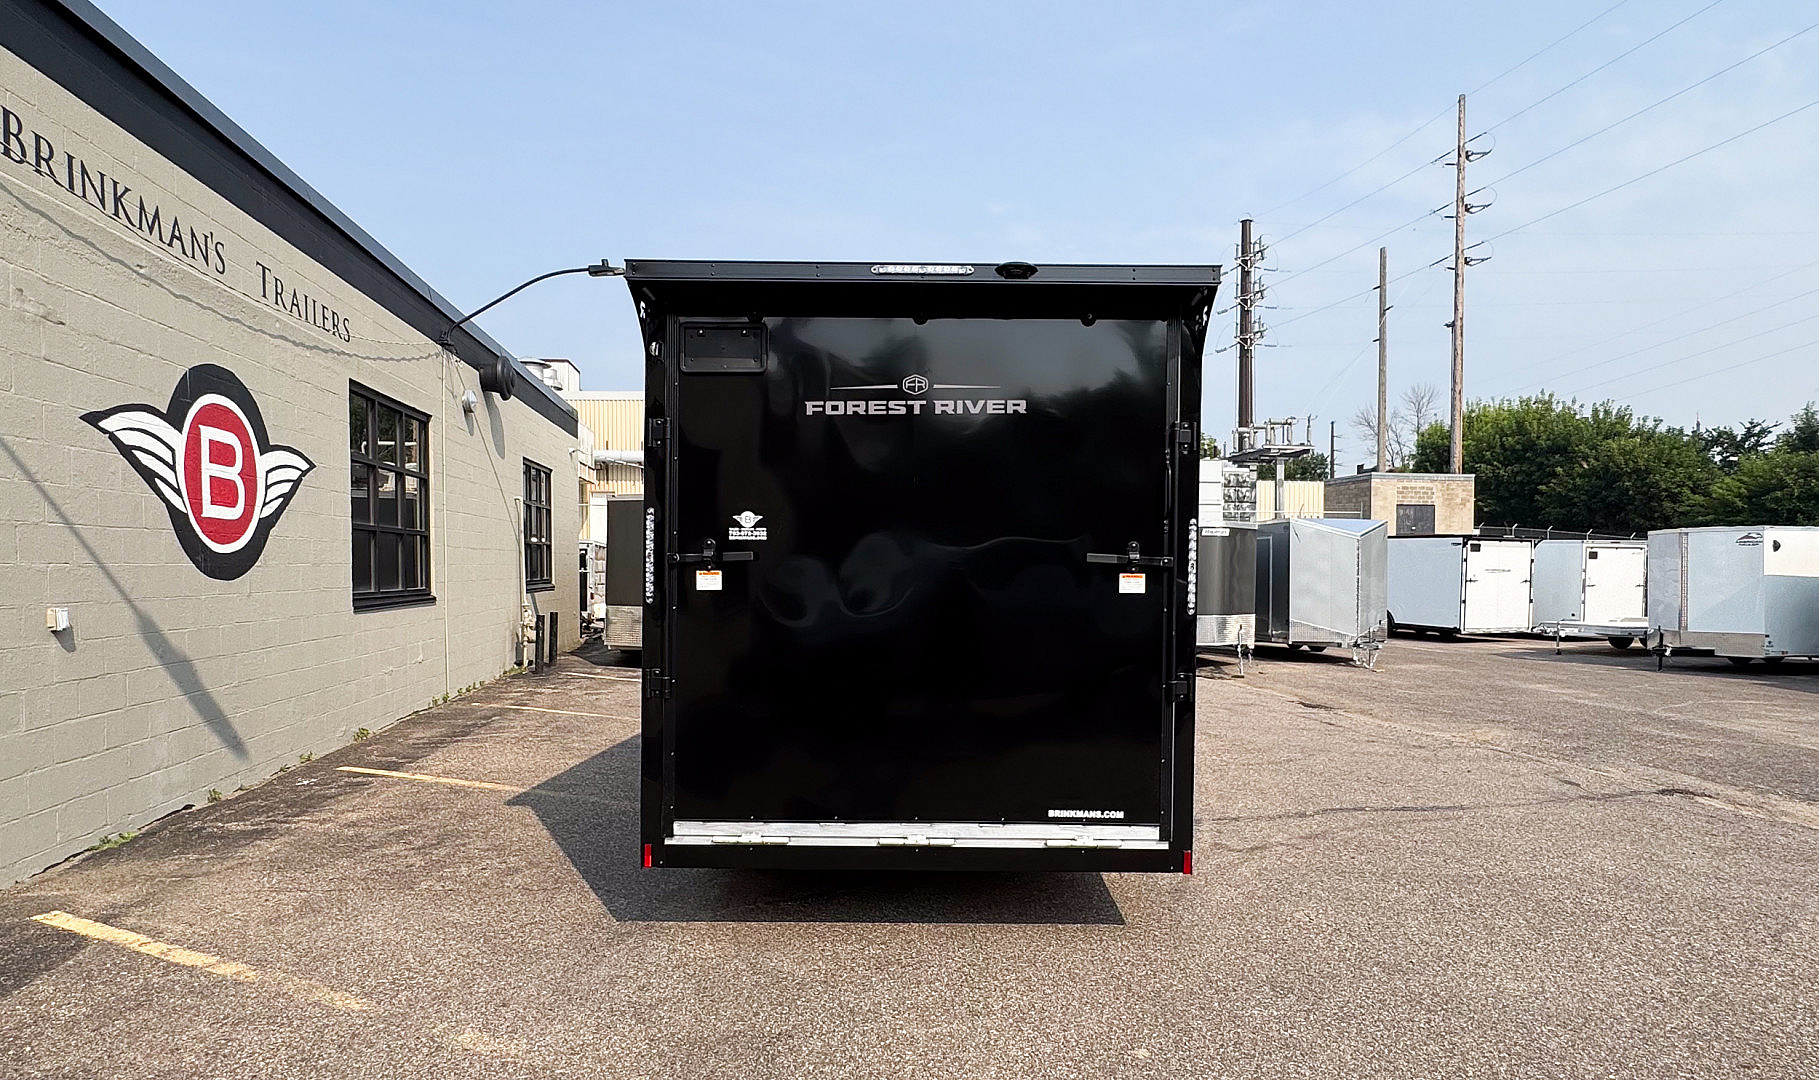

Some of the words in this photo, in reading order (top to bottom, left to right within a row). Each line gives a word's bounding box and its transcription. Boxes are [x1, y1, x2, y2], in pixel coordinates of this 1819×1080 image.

[0, 105, 226, 275] BRINKMAN'S
[255, 260, 351, 343] TRAILERS
[805, 401, 927, 415] FOREST
[933, 400, 1027, 414] RIVER
[198, 424, 246, 520] B
[1047, 809, 1125, 819] BRINKMANS.COM
